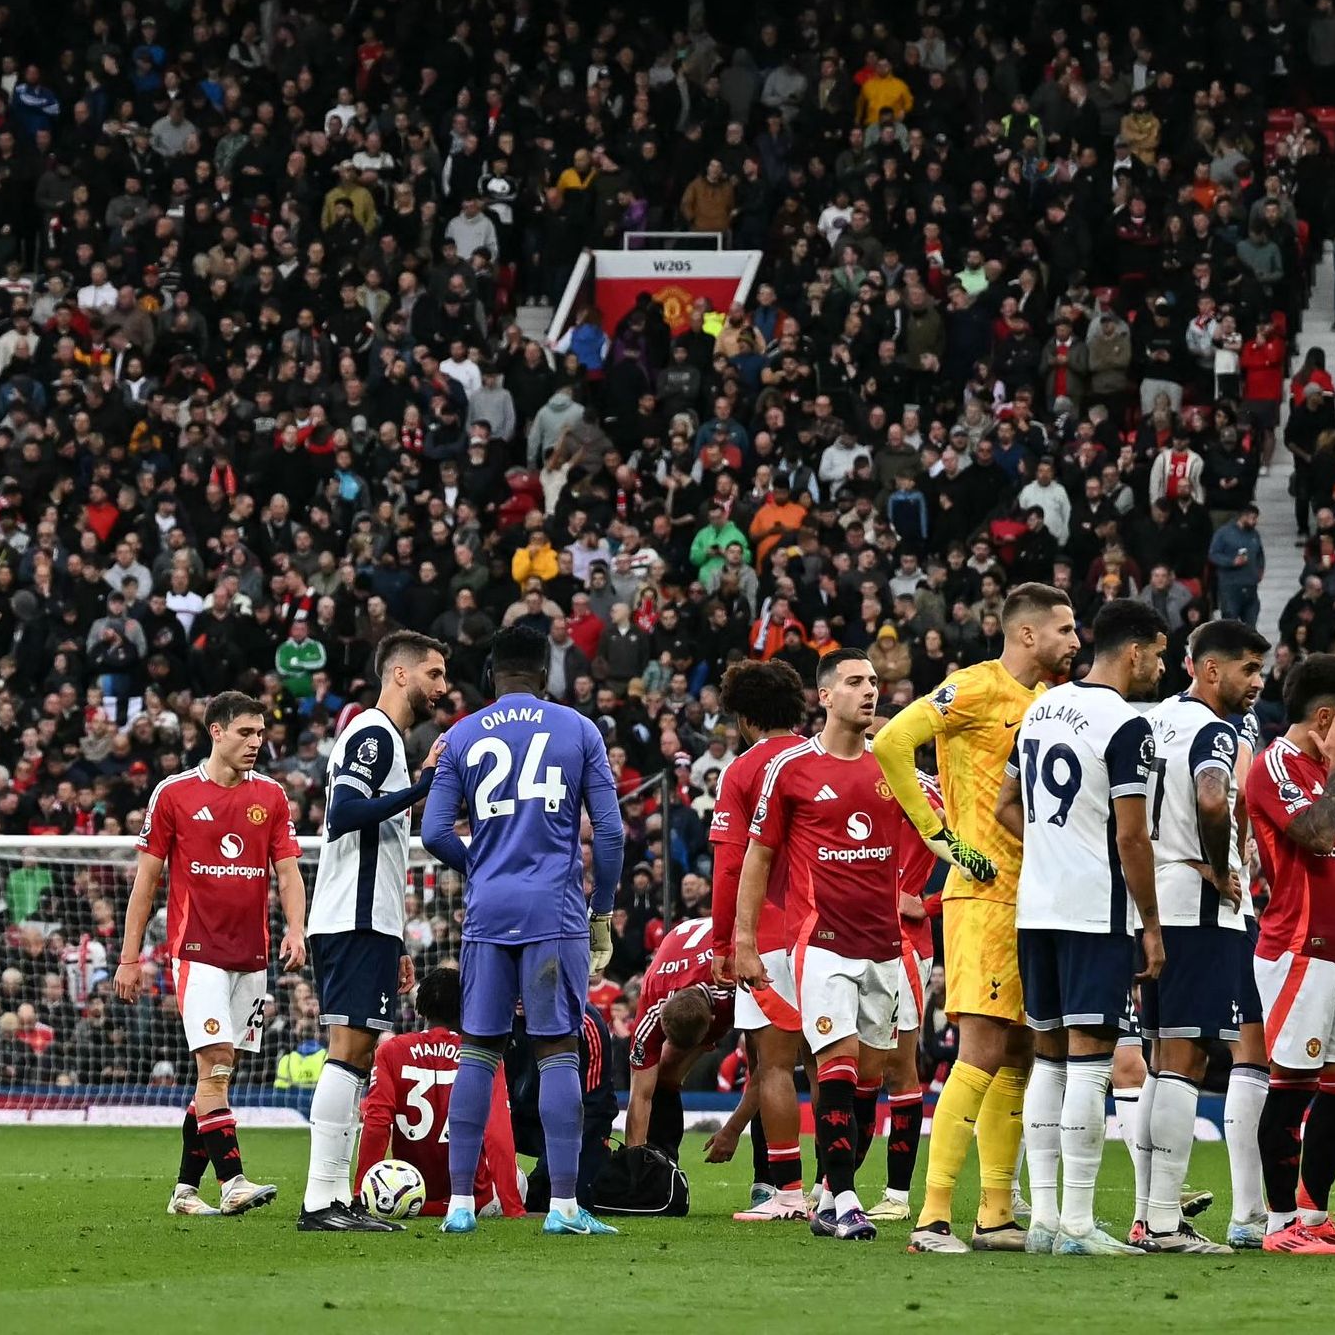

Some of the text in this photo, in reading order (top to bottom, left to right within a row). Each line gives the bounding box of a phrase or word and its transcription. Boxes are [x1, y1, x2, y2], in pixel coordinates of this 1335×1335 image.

[653, 260, 692, 272] W205
[481, 708, 544, 731] ONANA
[467, 732, 567, 821] 24
[1022, 738, 1083, 829] 19
[191, 862, 265, 880] Snapdragon
